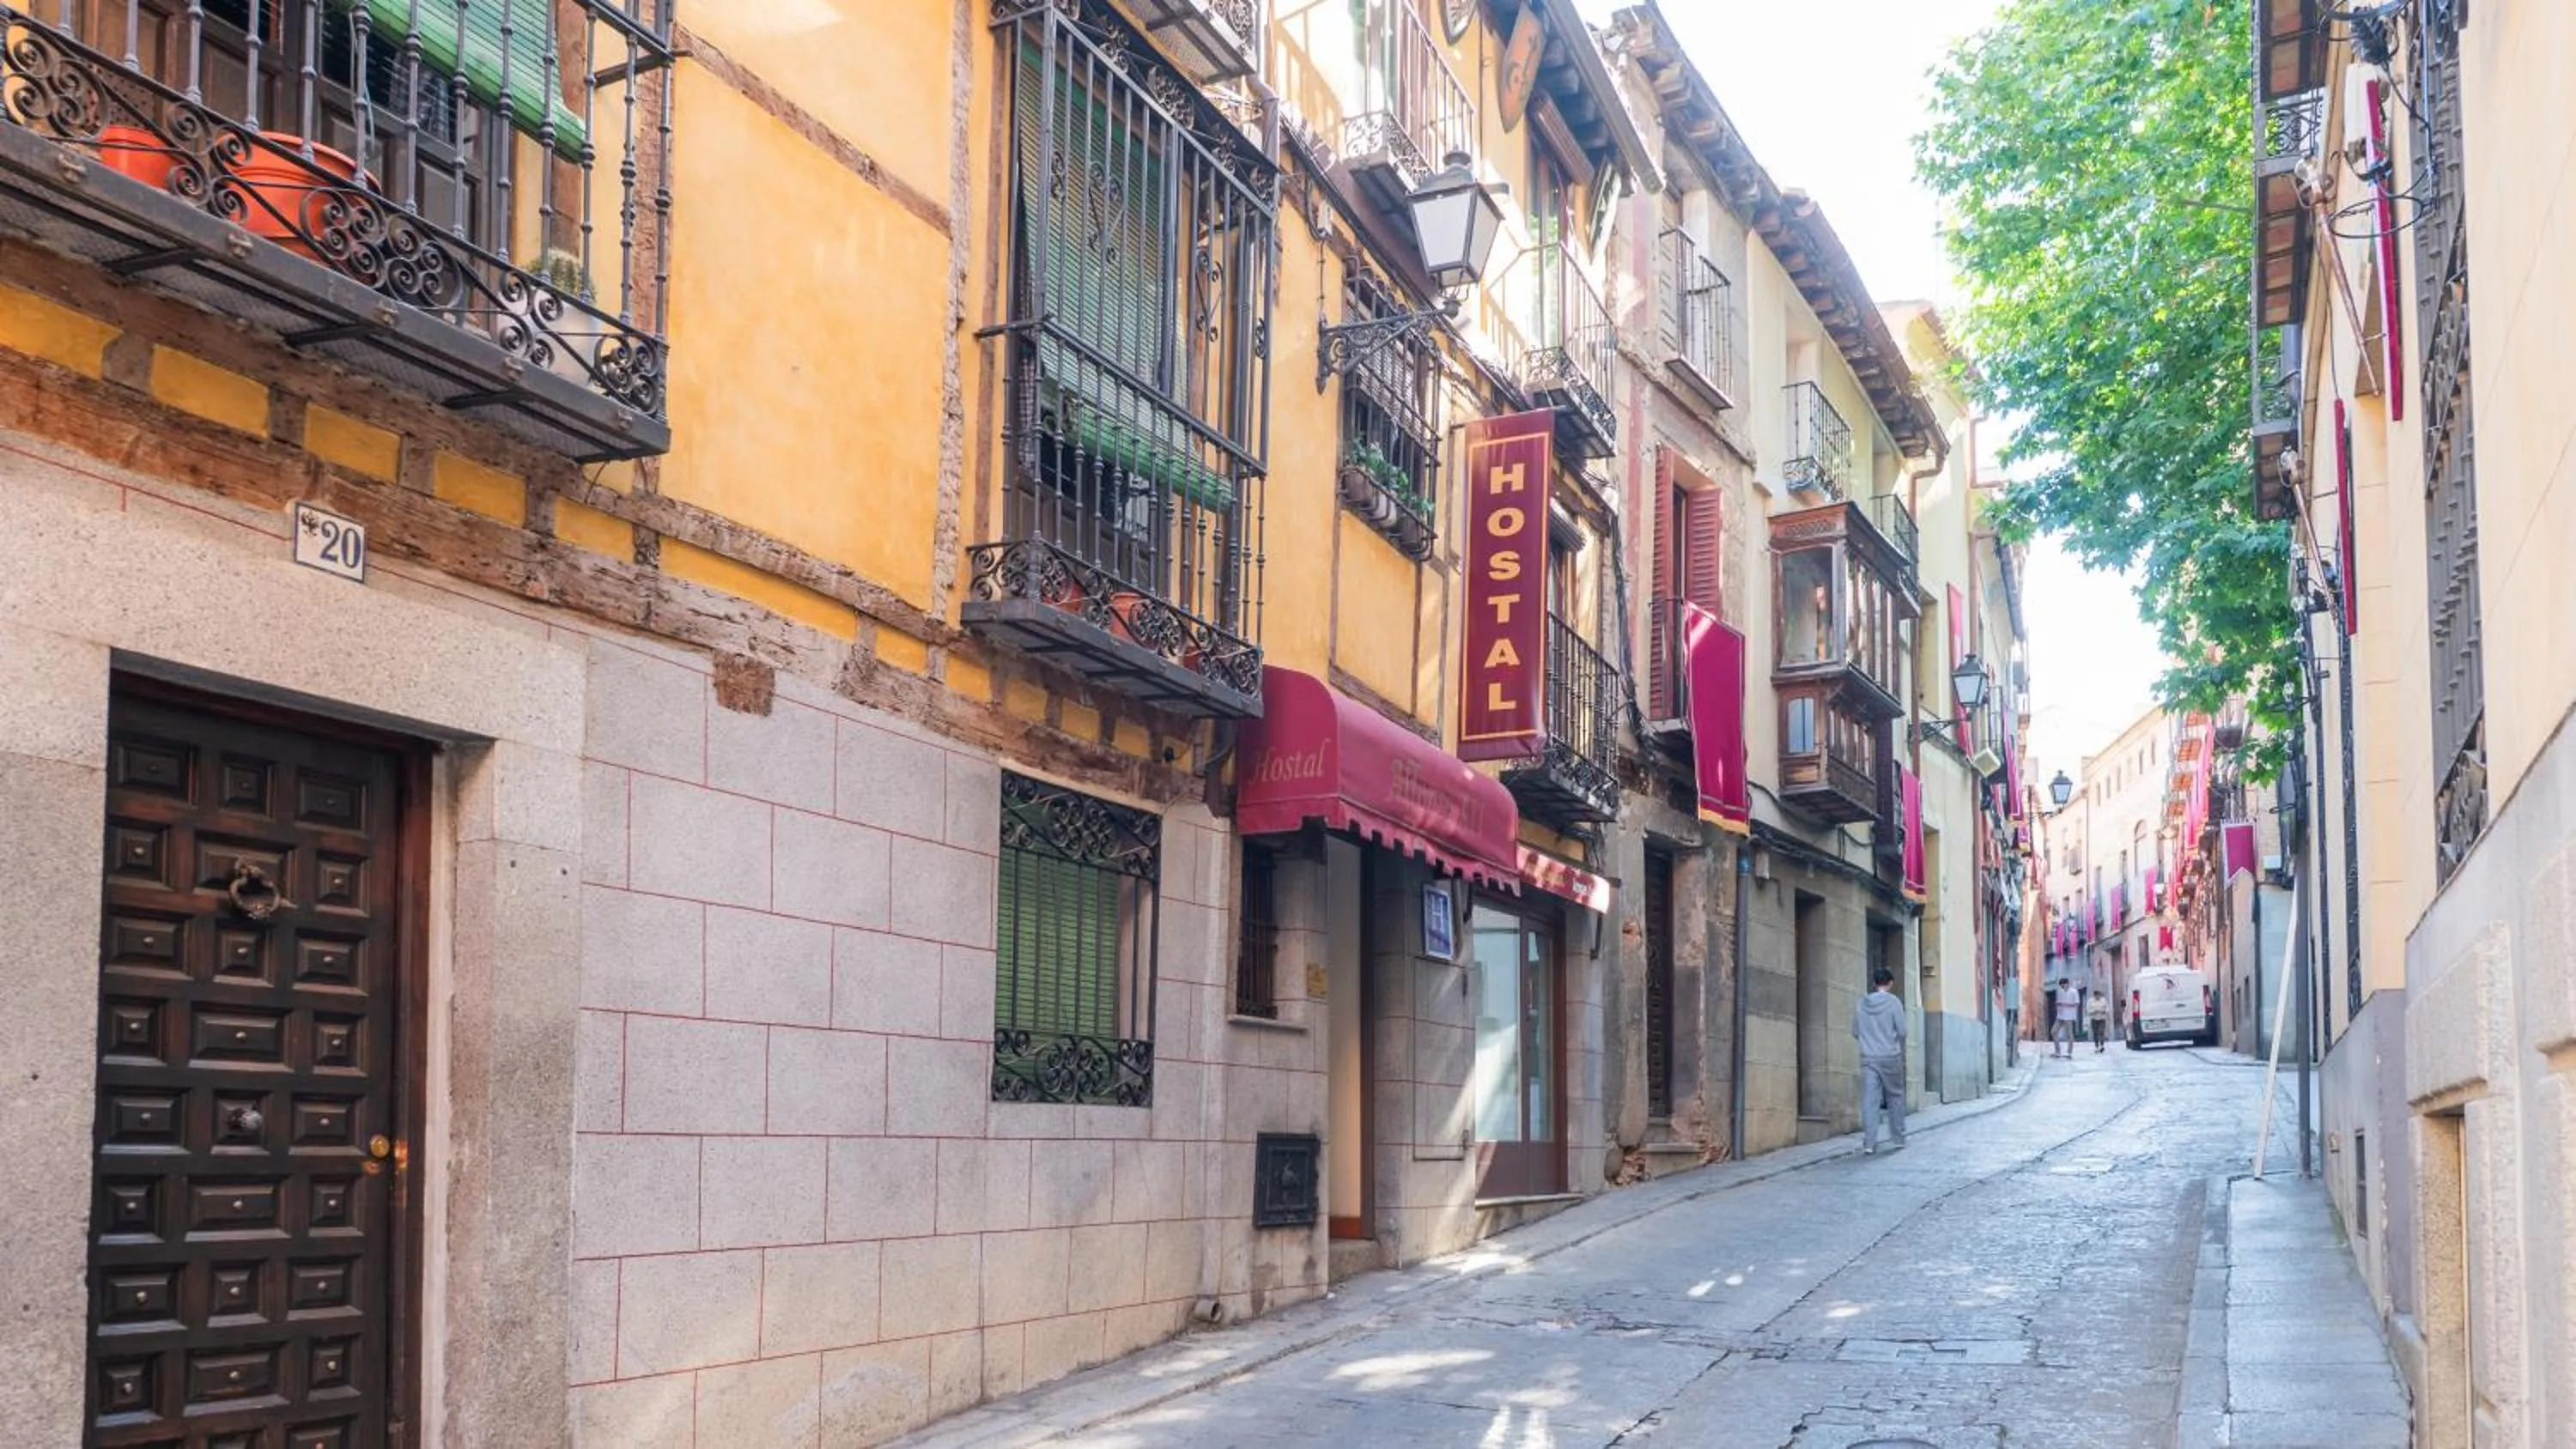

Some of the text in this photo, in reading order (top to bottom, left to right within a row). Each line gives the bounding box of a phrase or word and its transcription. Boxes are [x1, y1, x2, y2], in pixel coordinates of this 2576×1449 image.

[319, 520, 361, 569] 20
[1484, 463, 1525, 712] HOSTAL
[1248, 737, 1333, 785] Hostal
